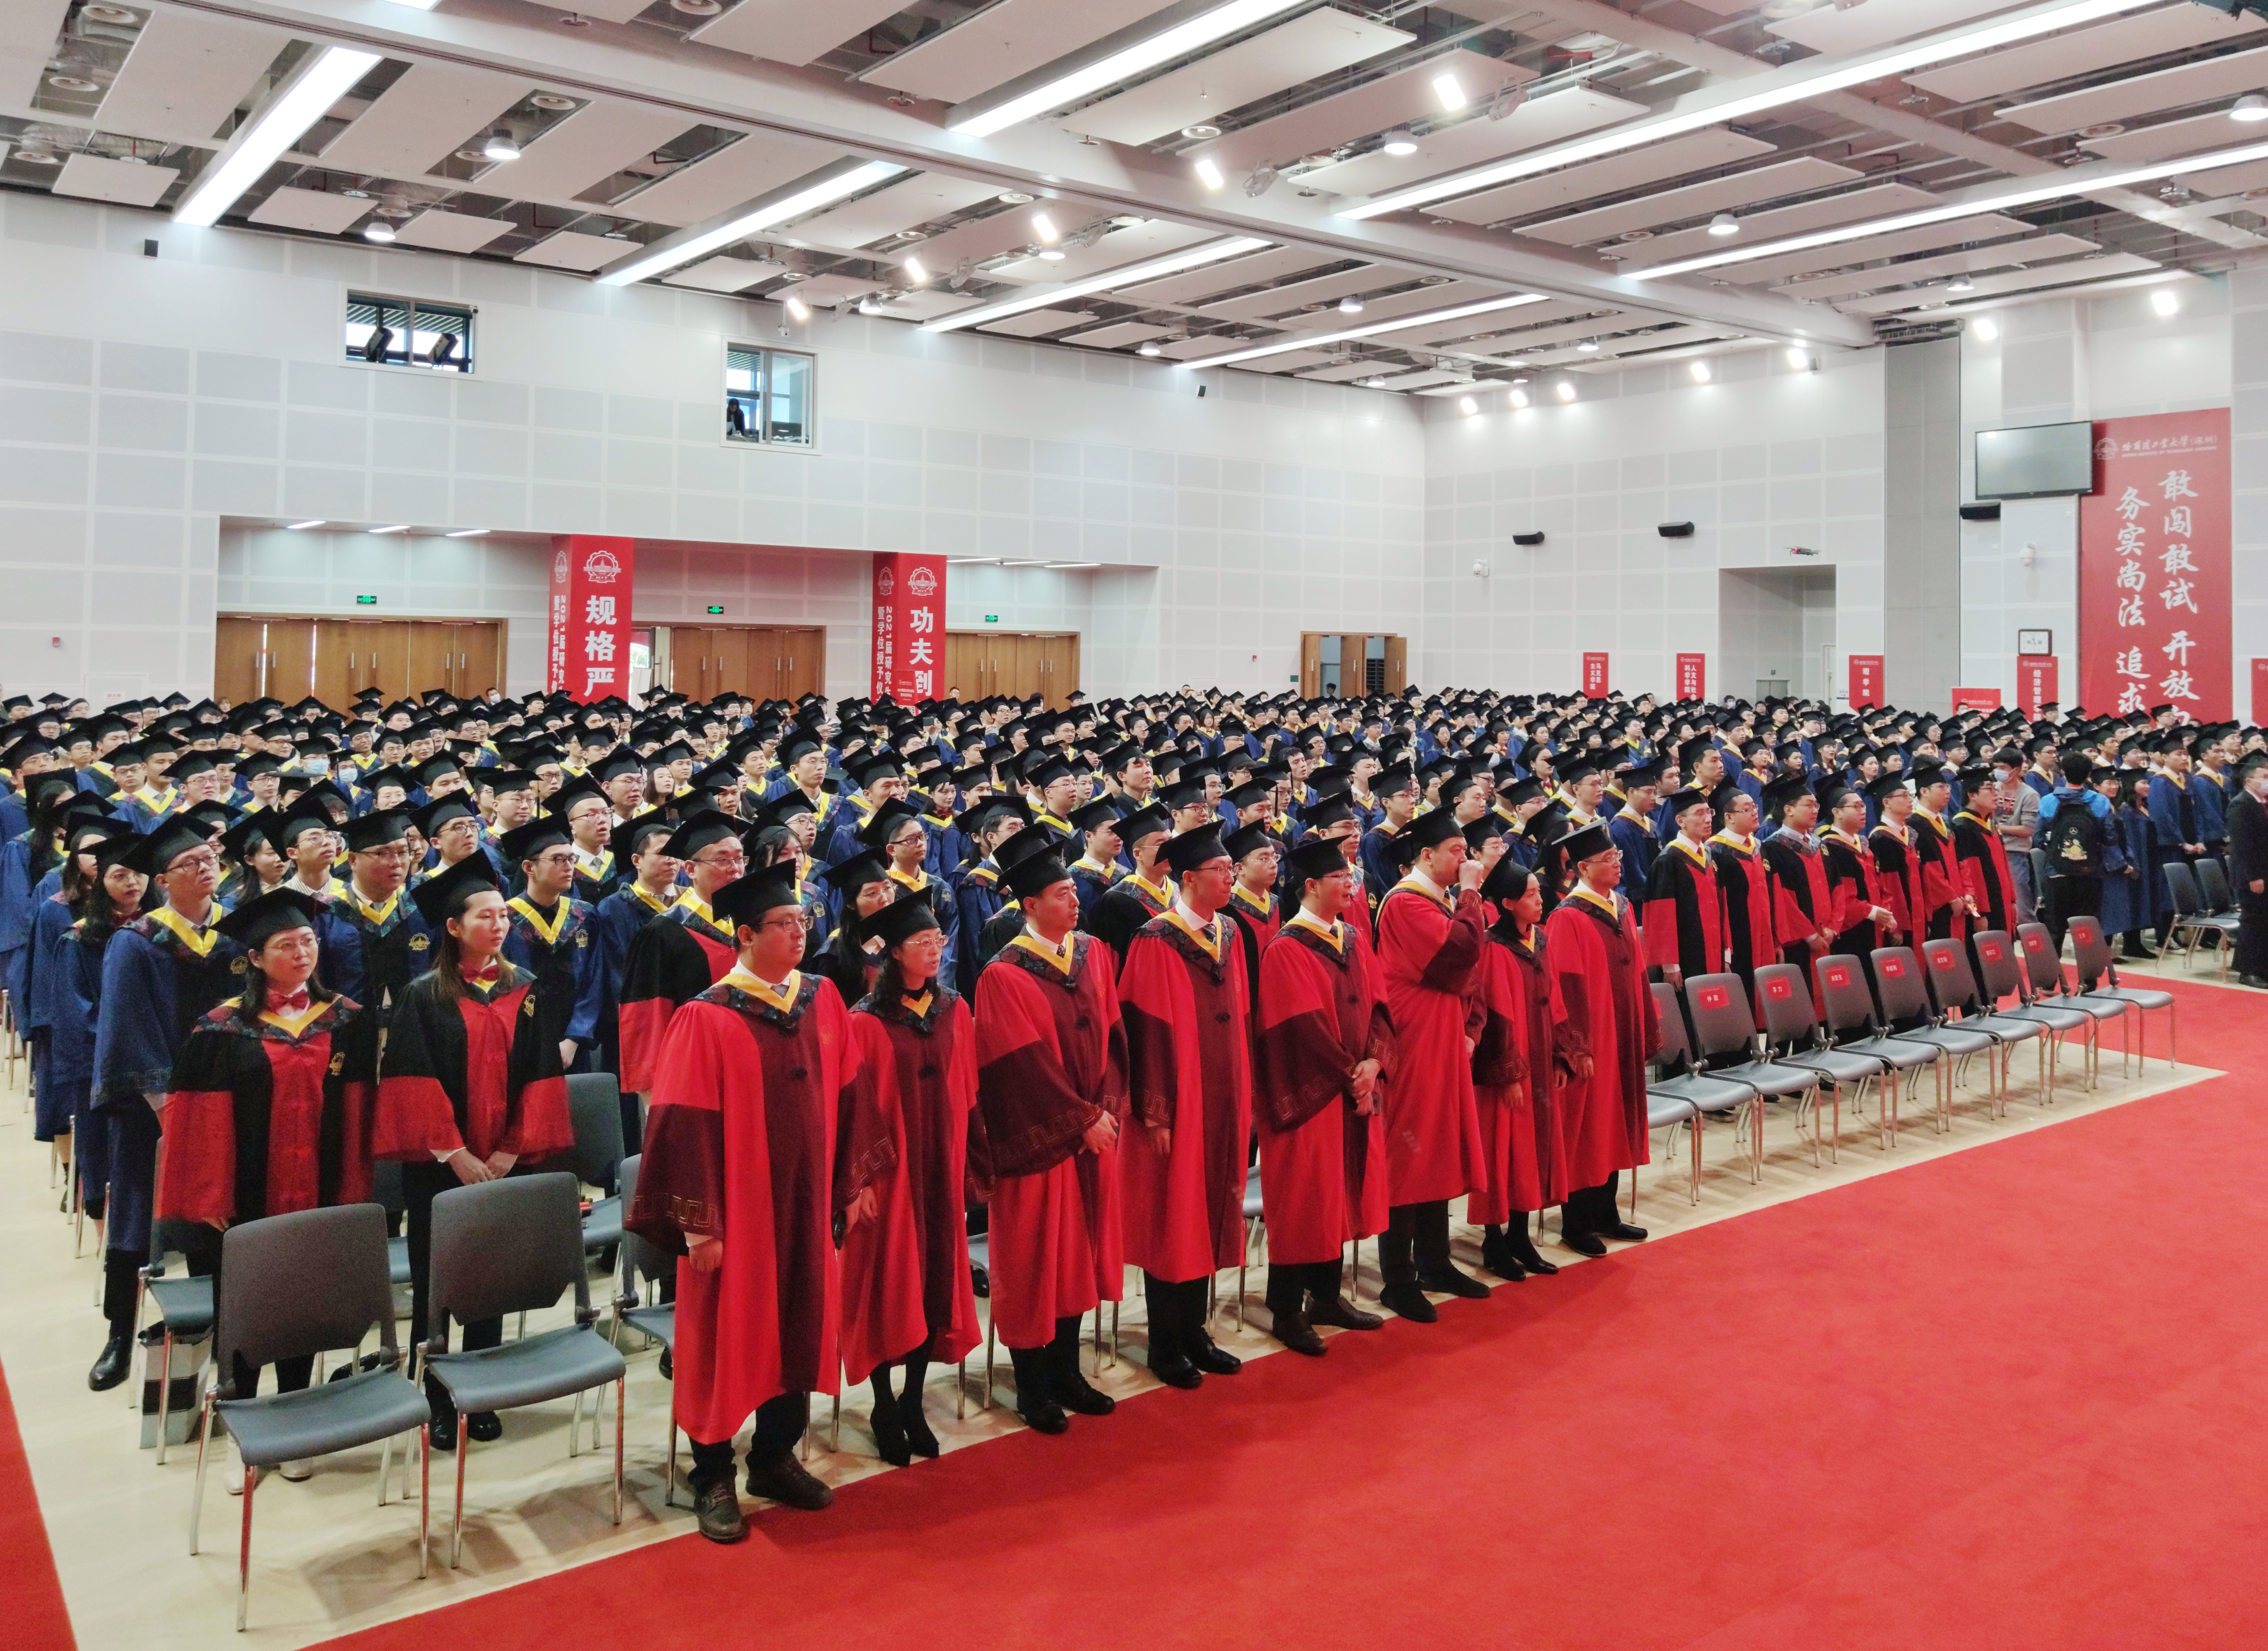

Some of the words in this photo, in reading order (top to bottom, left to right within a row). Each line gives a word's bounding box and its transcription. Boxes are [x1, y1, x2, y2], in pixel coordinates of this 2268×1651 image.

[2115, 486, 2150, 627] 务实尚法
[2158, 470, 2199, 614] 敢闯敢试
[583, 595, 617, 696] 规格严
[2116, 646, 2151, 713] 追求
